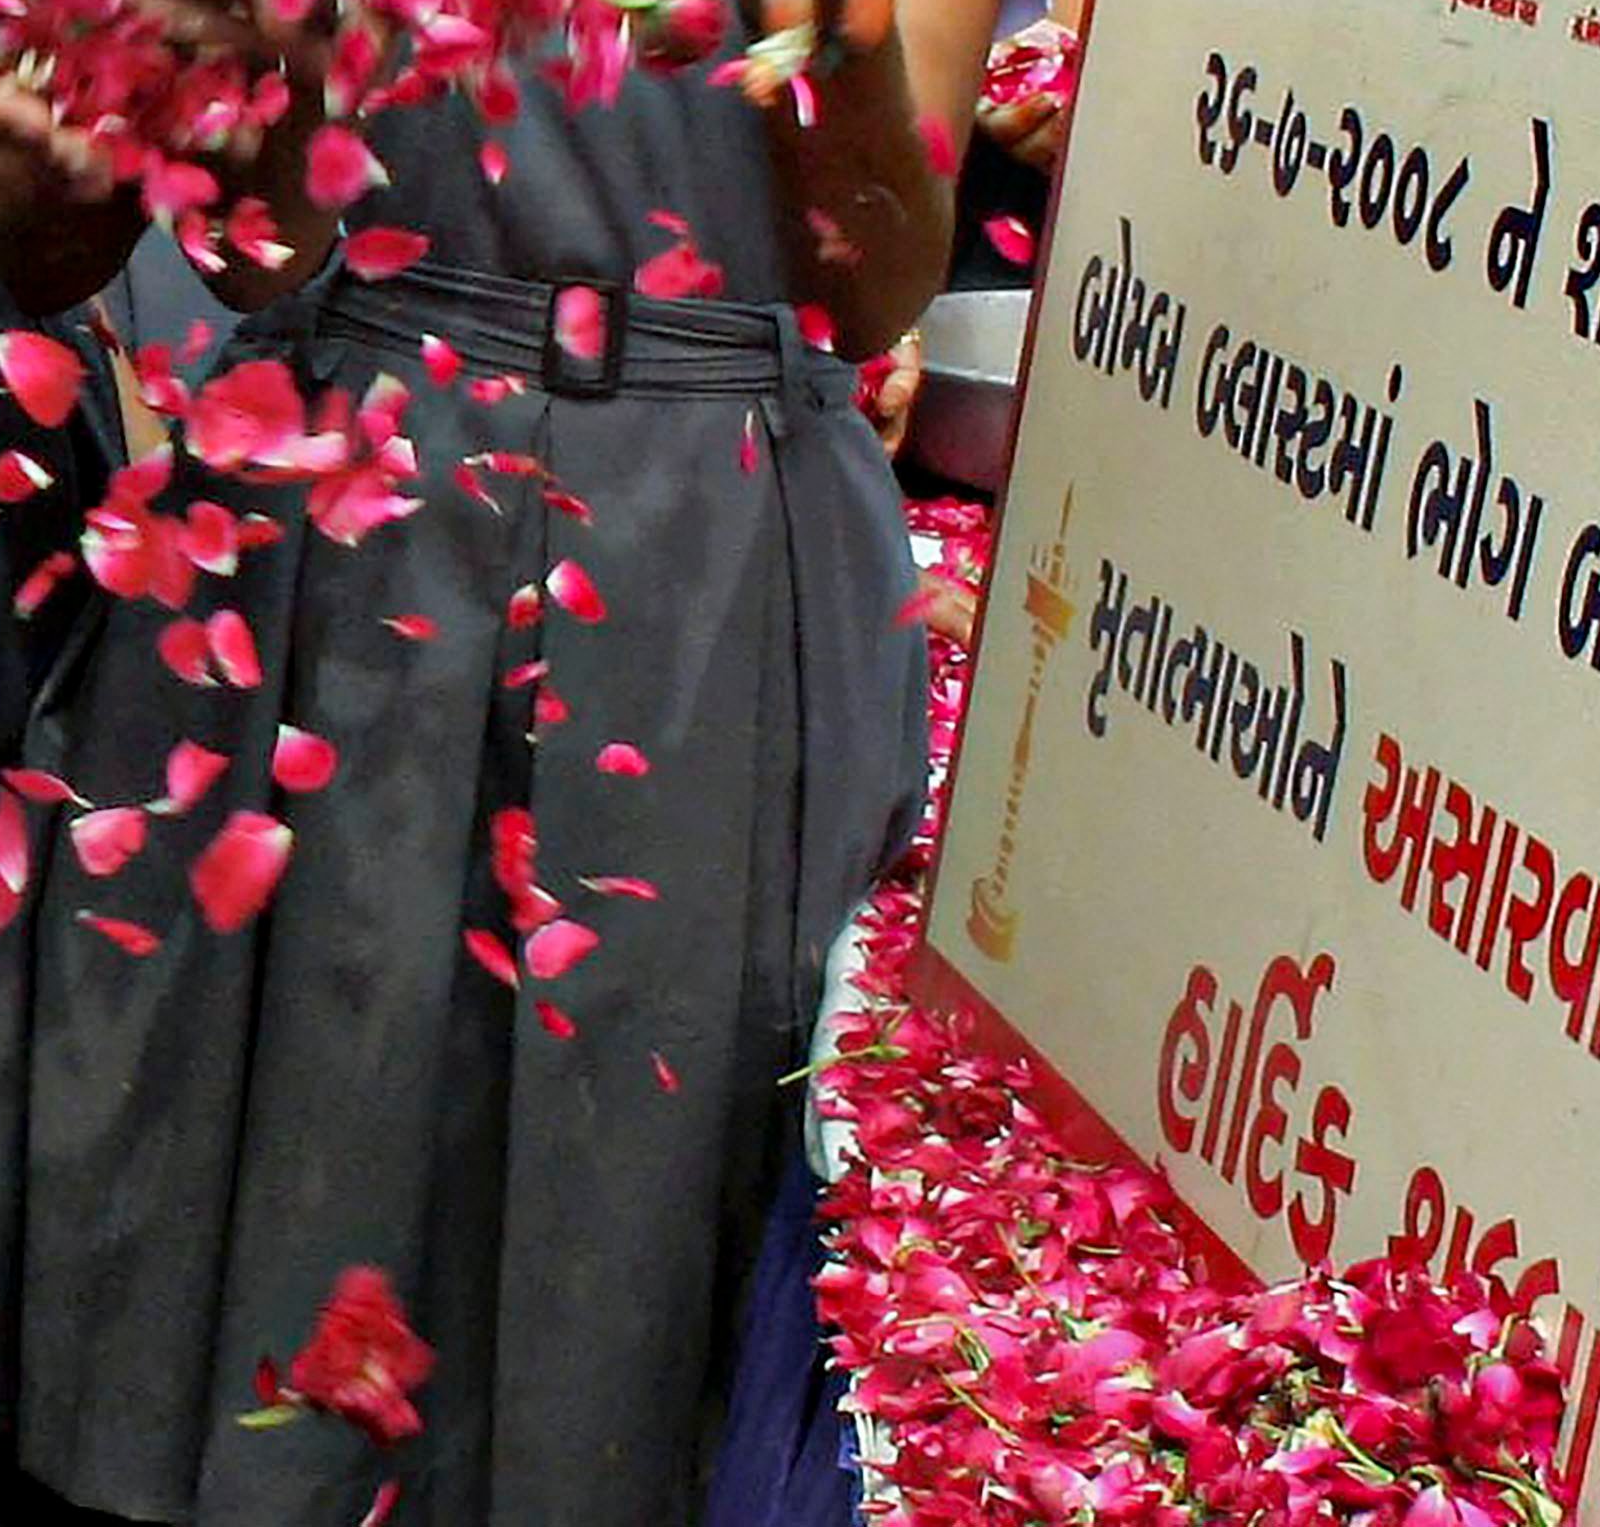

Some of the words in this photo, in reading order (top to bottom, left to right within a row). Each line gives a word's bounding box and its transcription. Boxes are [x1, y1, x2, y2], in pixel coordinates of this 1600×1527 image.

[1487, 117, 1552, 308] ને
[1073, 216, 1186, 410] બોમ્બ
[1196, 323, 1403, 533] બ્લાસ્ટમાં
[1406, 398, 1546, 622] ભોગ
[1156, 953, 1356, 1267] હાર્દિક
